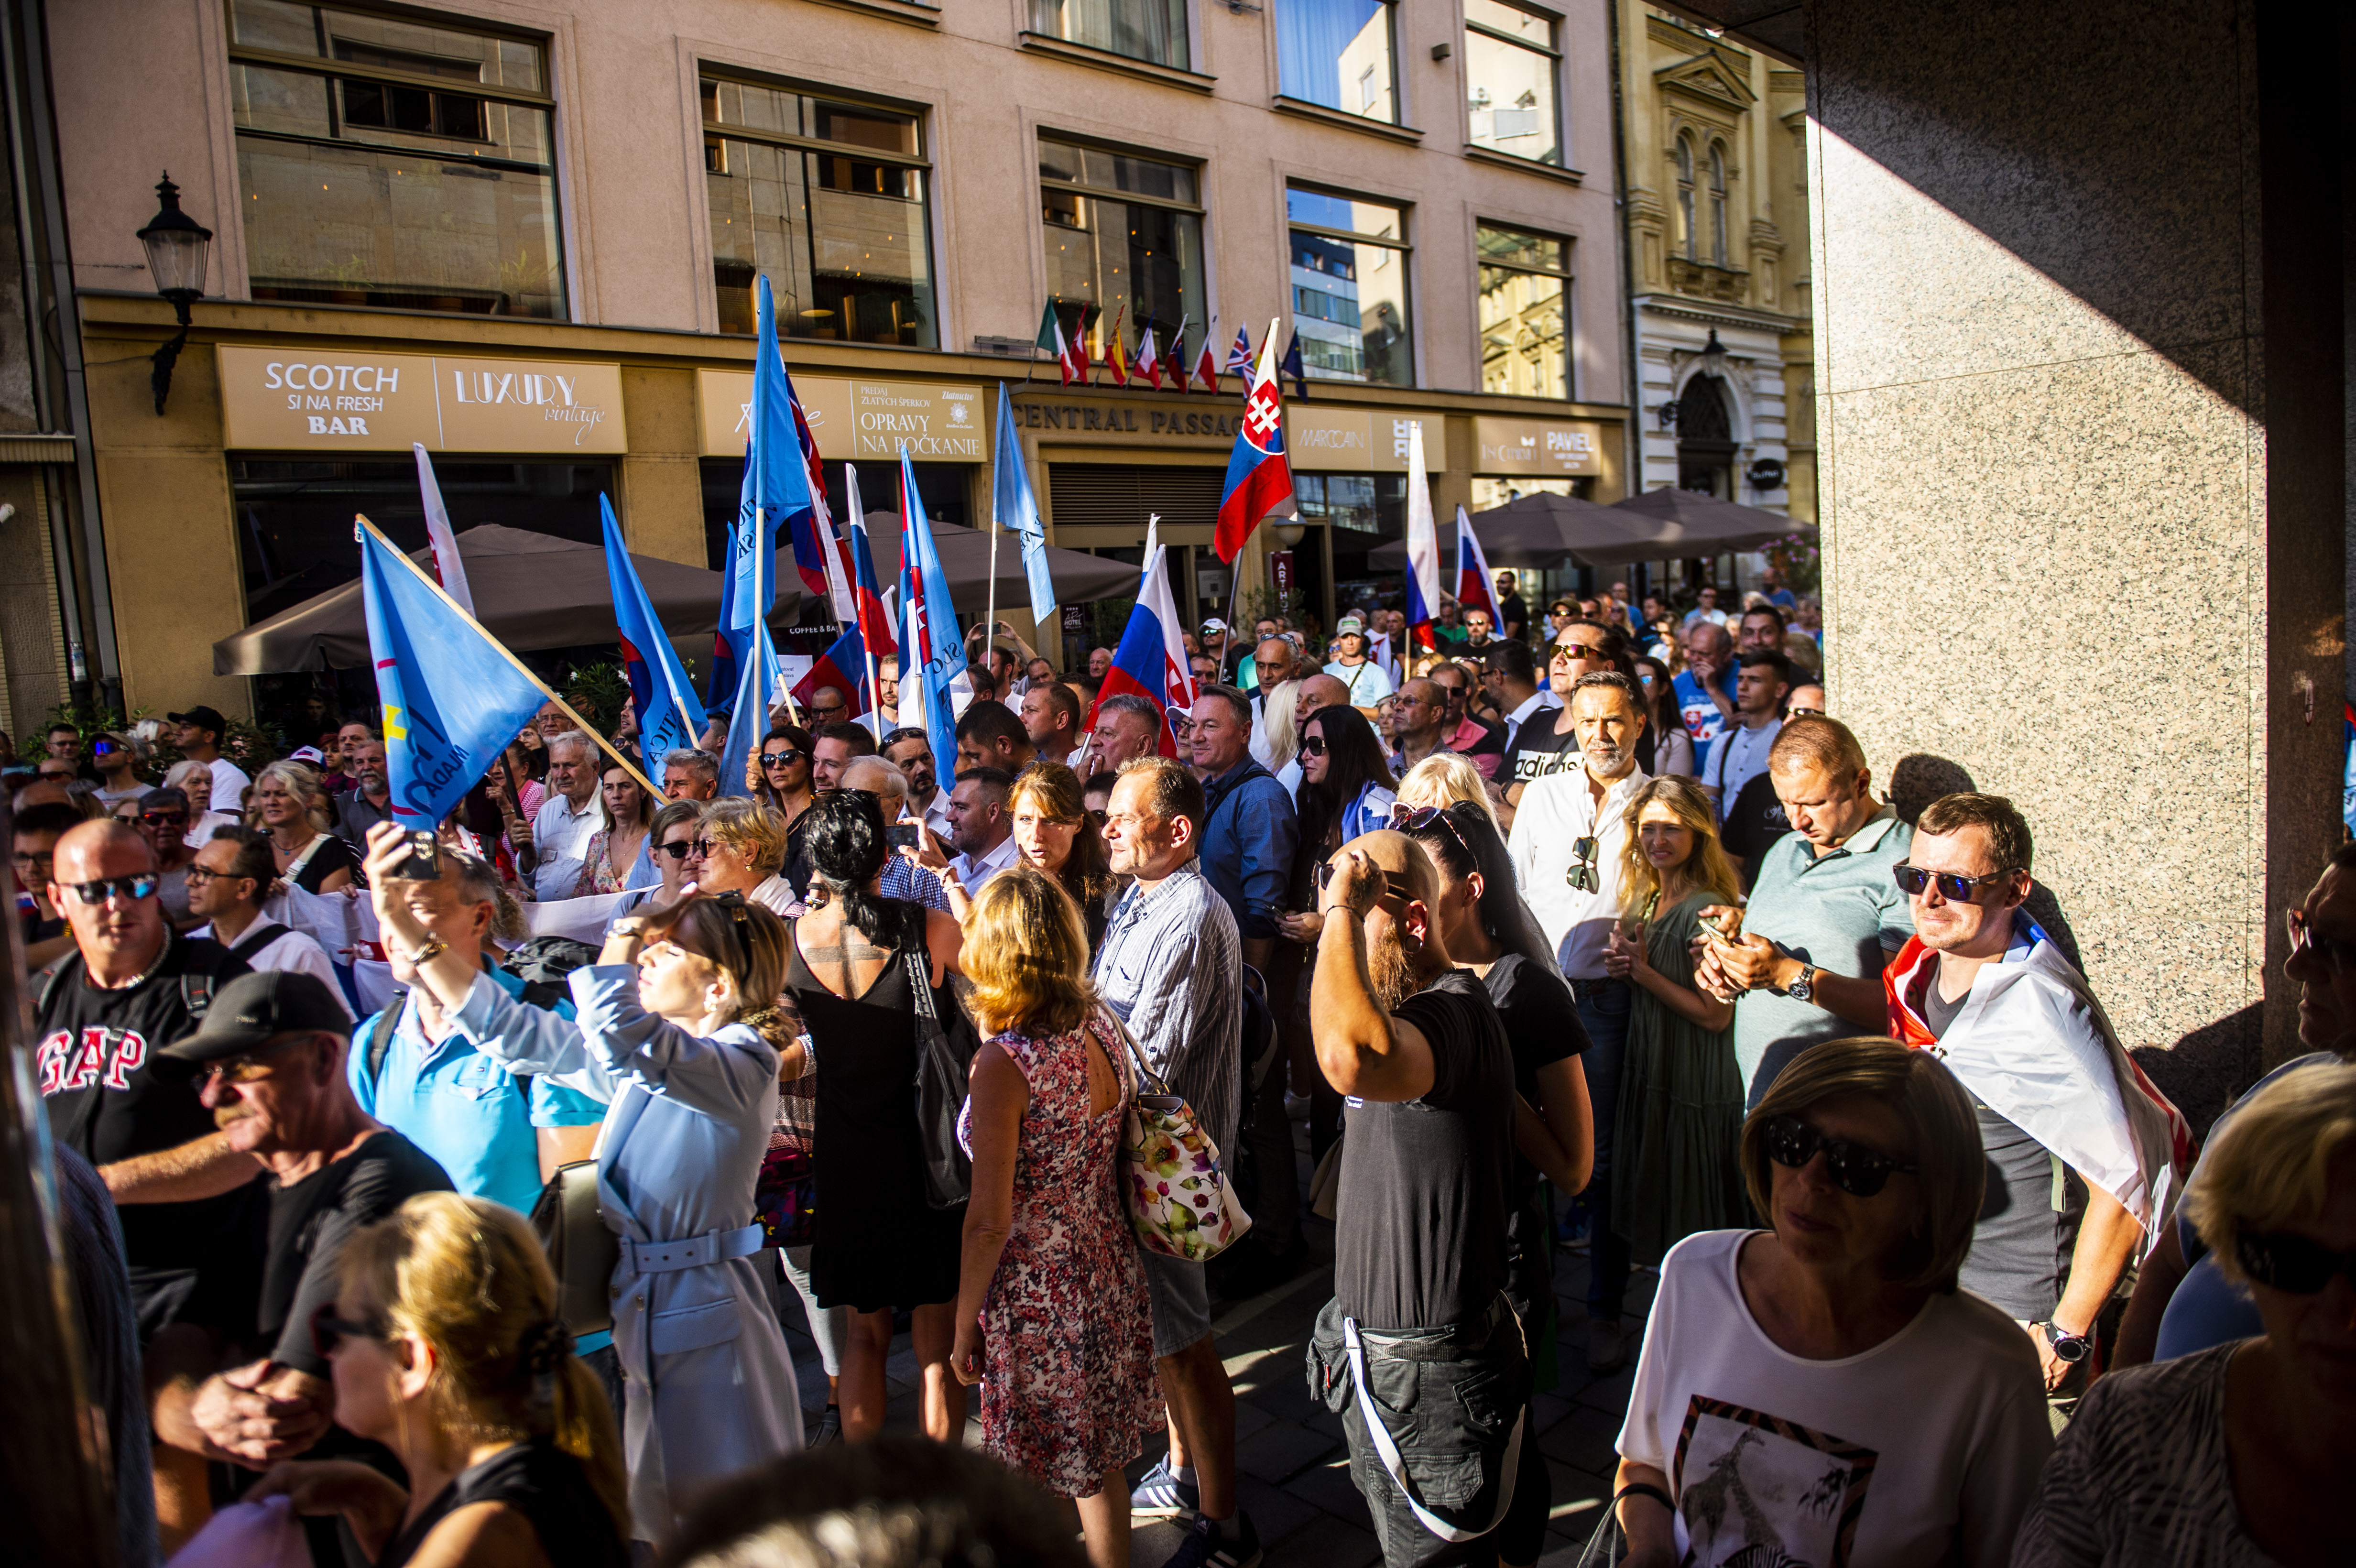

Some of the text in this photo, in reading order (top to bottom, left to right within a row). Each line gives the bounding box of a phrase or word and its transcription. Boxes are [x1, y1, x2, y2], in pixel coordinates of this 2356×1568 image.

[264, 362, 399, 393] SCOTCH
[453, 370, 576, 407] LUXURY
[861, 386, 888, 396] PREDAJ
[287, 394, 383, 412] SI NA FRESH
[861, 396, 931, 408] ZLATÝCH ŠPERKOV
[307, 415, 369, 436] BAR
[544, 401, 606, 446] vintage
[861, 412, 930, 432] OPRAVY
[1010, 403, 1243, 436] CENTRAL PASSAG
[862, 433, 980, 455] NA POČKANIE
[1547, 431, 1594, 451] PAVIEL
[36, 1026, 147, 1098] GAP
